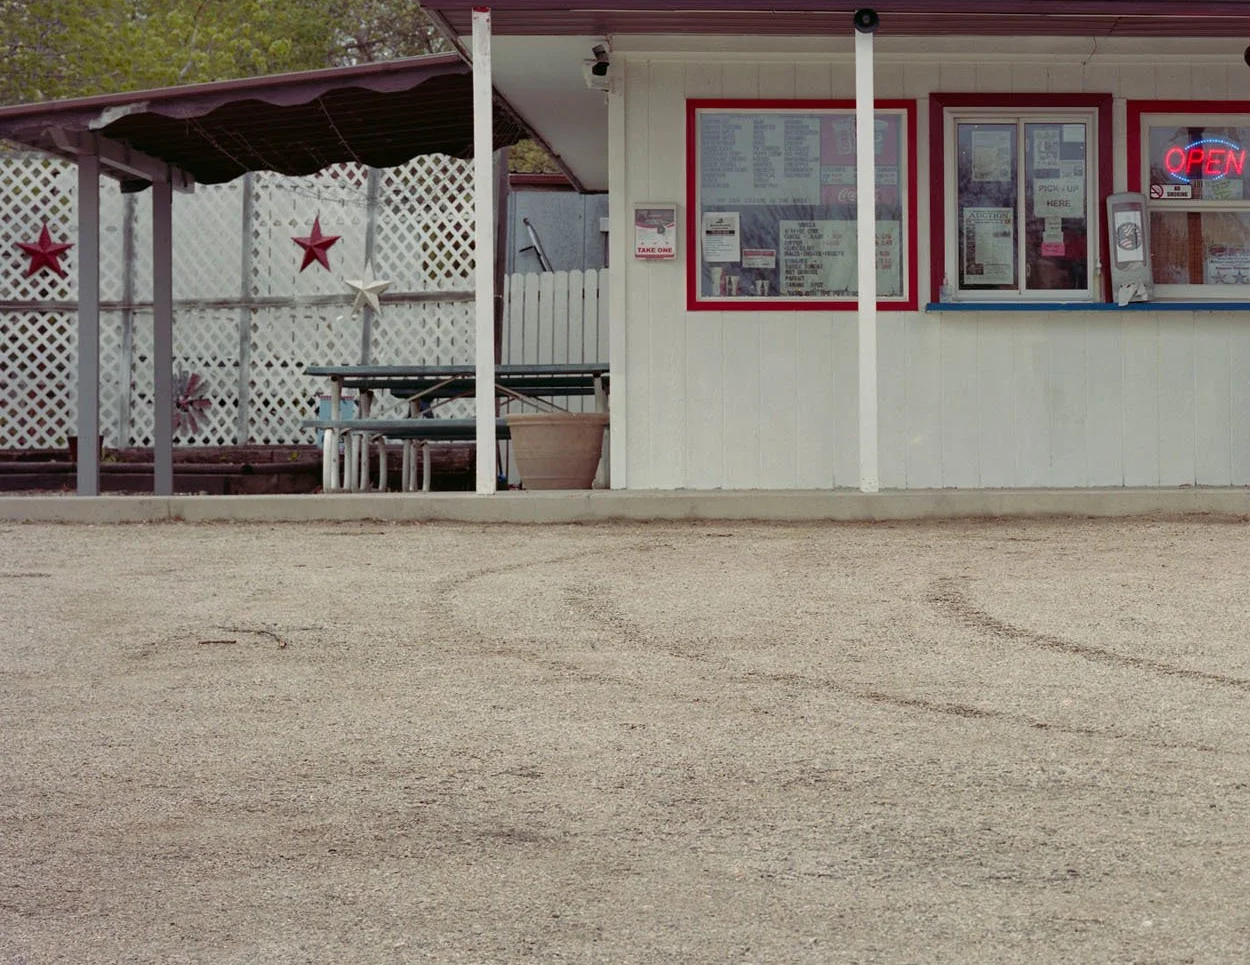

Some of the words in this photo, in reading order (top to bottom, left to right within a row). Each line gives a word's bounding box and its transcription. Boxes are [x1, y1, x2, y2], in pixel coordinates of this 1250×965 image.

[1165, 146, 1246, 175] OPEN
[1046, 199, 1071, 207] HERE
[968, 211, 1010, 219] AUCTION
